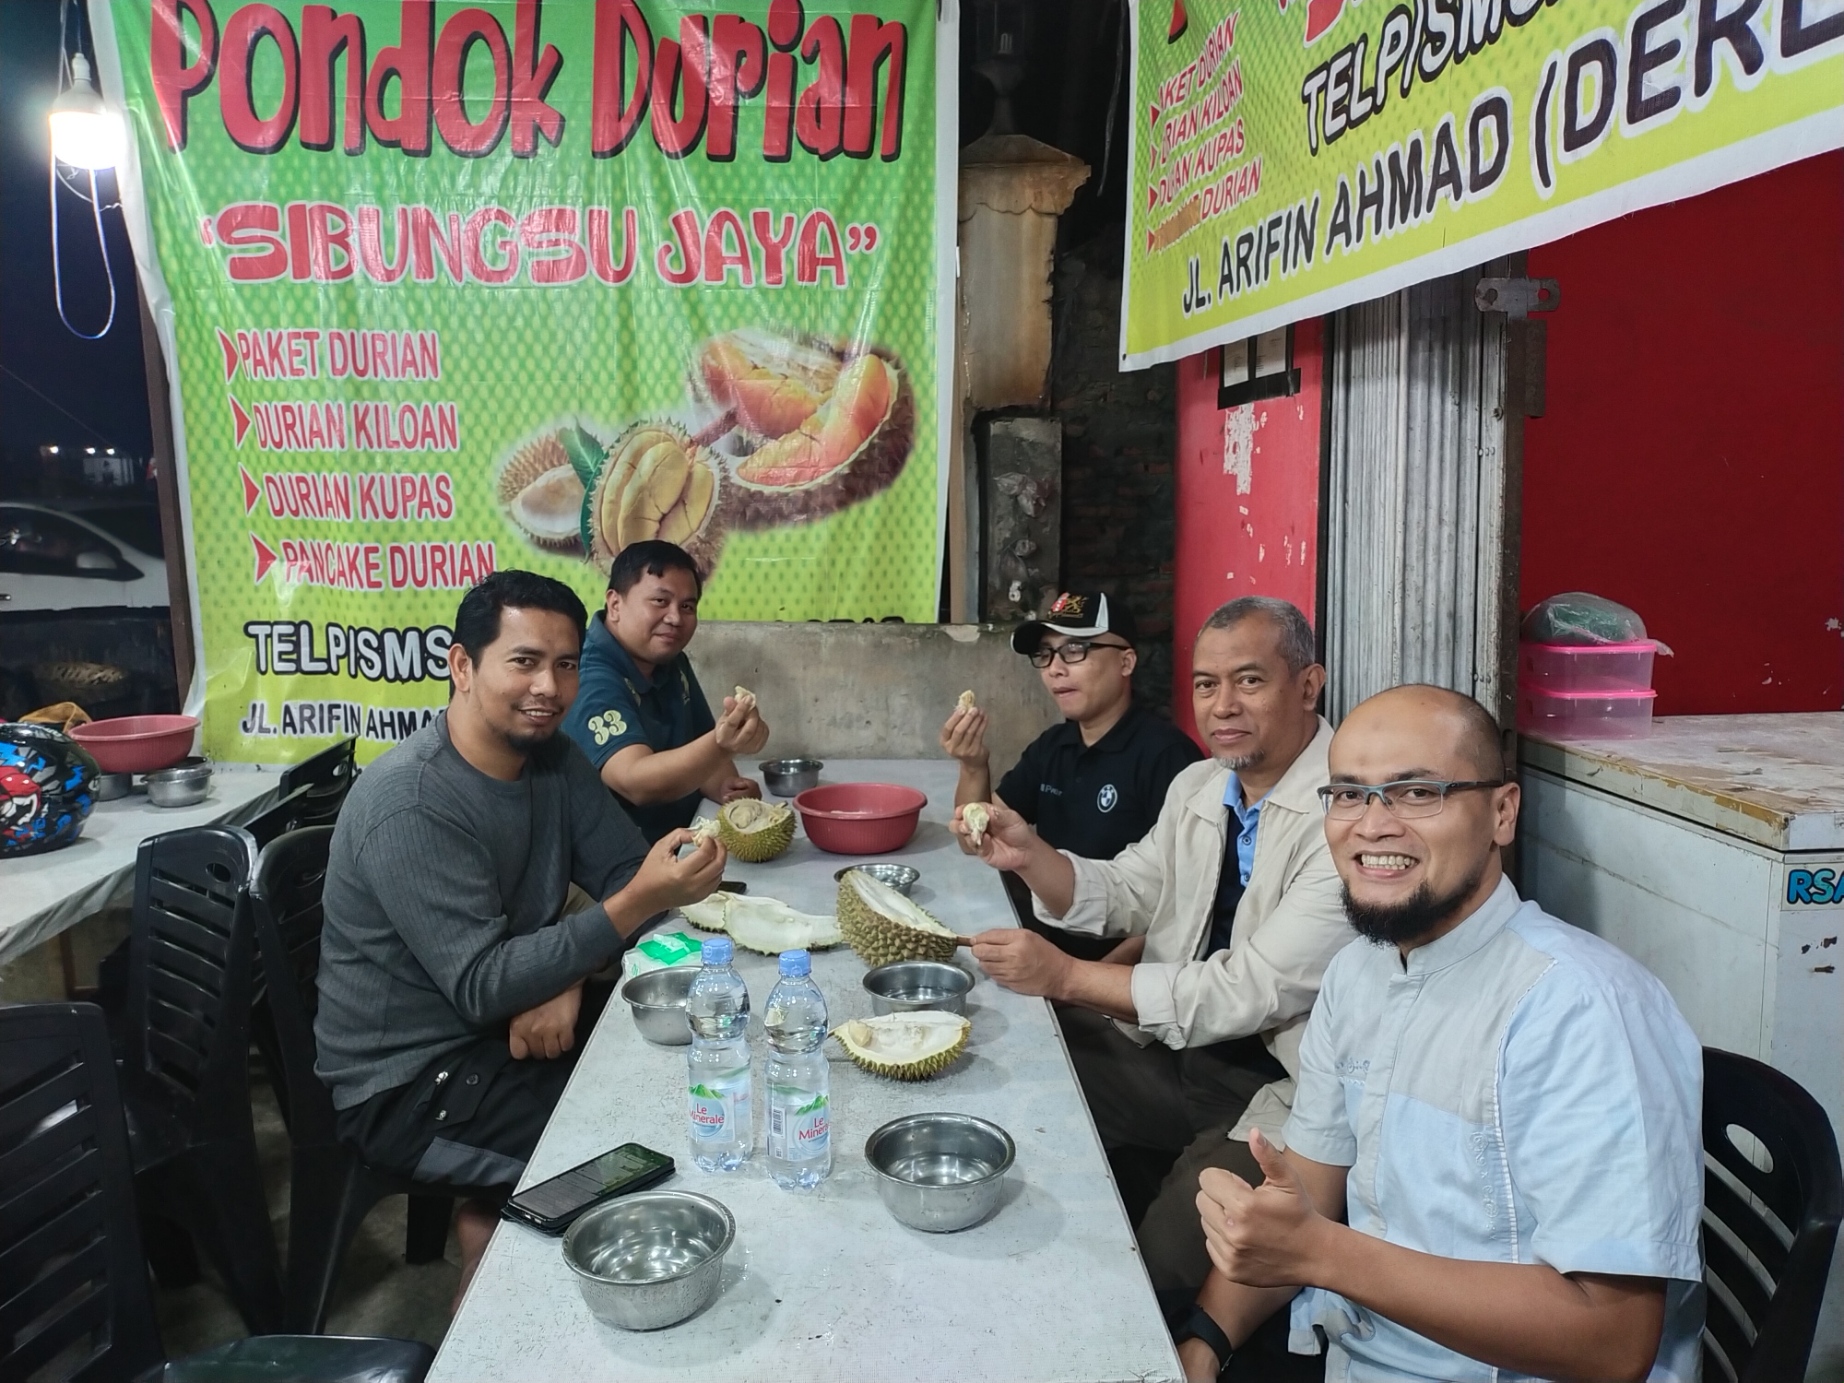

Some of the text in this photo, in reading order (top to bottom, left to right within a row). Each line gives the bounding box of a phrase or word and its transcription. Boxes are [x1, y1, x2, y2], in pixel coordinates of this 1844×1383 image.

[1197, 10, 1239, 89] DURIAN
[151, 0, 907, 162] Pondok Durian
[1200, 59, 1243, 132] KILOAN
[1194, 117, 1245, 179] KUPAS
[1183, 257, 1211, 314] JL.
[1219, 196, 1319, 300] ARIFIN
[1326, 96, 1509, 256] AHMAD
[1200, 155, 1261, 220] DURIAN
[237, 329, 440, 380] PAKET DURIAN
[252, 402, 459, 450] DURIAN KILOAN
[263, 473, 454, 521] DURIAN KUPAS
[281, 540, 494, 589] PANCAKE DURIAN
[242, 702, 448, 741] JL. ARIFIN AHMA
[588, 709, 628, 746] 33
[696, 1102, 708, 1115] Le
[814, 1117, 824, 1129] Le
